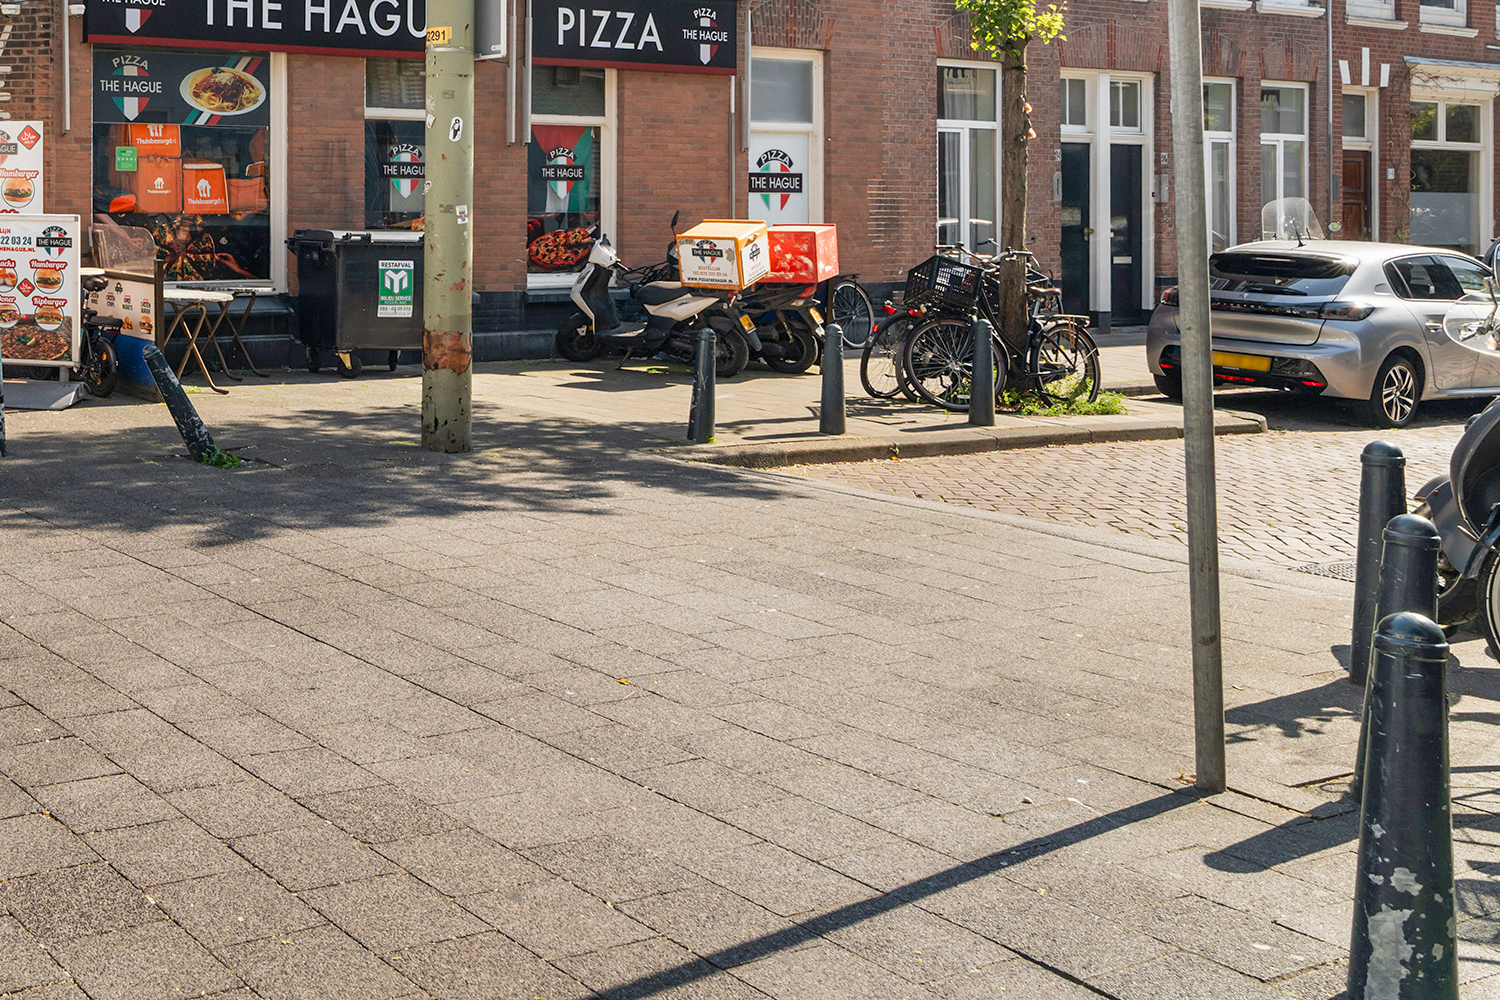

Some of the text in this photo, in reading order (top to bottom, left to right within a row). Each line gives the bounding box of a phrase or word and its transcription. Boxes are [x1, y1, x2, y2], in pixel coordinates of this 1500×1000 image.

[692, 8, 716, 20] PIZZA
[558, 7, 664, 52] PIZZA
[682, 29, 728, 42] THE HAGUE
[112, 55, 149, 70] PIZZA
[100, 79, 162, 94] THE HAGUE
[136, 137, 176, 146] Thuisbezorgd.nl
[392, 144, 420, 156] PIZZA
[550, 148, 574, 160] PIZZA
[761, 150, 790, 165] PIZZA
[383, 164, 425, 176] THE HAGU
[542, 168, 583, 178] THE HAGUE
[750, 176, 800, 189] THE HAGUE
[44, 226, 66, 236] PIZZA
[12, 236, 21, 245] 03
[22, 236, 32, 246] 24
[50, 238, 72, 246] HAGUE
[30, 260, 68, 271] Hamburger
[32, 298, 67, 308] Kipburger
